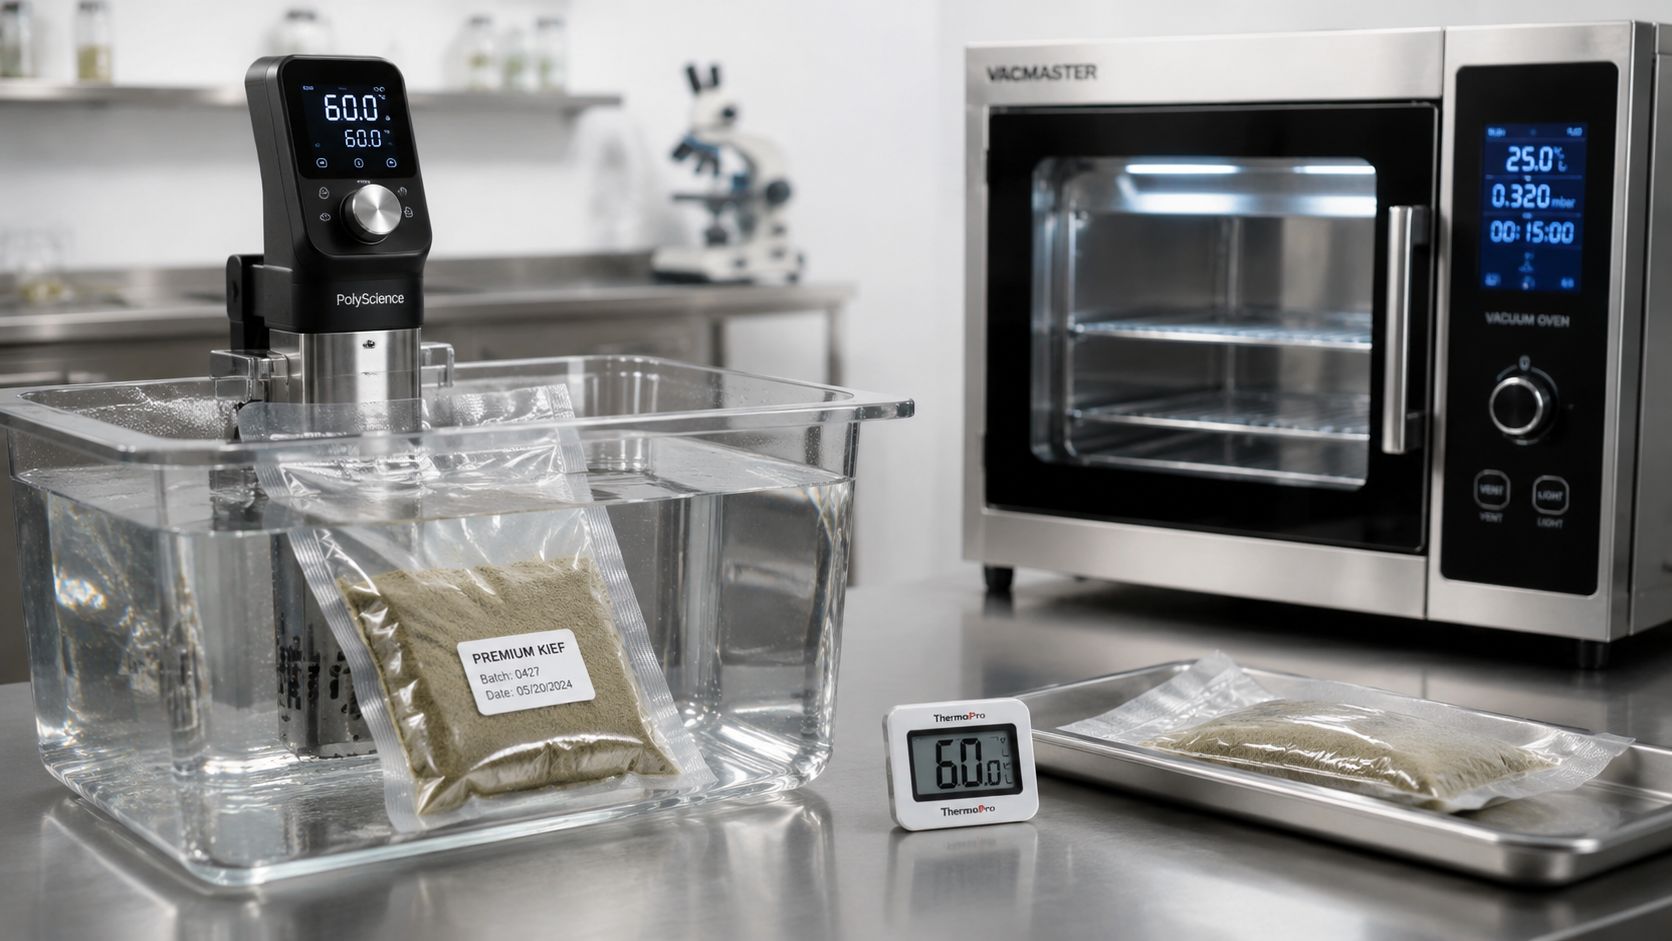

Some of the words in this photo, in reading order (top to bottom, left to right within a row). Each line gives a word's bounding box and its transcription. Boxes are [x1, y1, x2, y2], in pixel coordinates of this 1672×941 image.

[986, 64, 1097, 81] VACMASTER
[324, 94, 378, 121] 60.0
[344, 129, 381, 148] 60.0
[1506, 146, 1553, 172] 25.0
[1492, 183, 1550, 208] 0.320
[1490, 220, 1575, 244] 00:15:00
[336, 293, 405, 307] PolyScience
[1485, 312, 1535, 325] VACUUM
[1537, 314, 1570, 327] OVEN
[472, 646, 535, 664] PREMIUM
[537, 642, 566, 656] KIEF
[480, 671, 514, 684] Batch:
[514, 666, 540, 680] 0427
[485, 687, 514, 701] Date:
[516, 679, 573, 696] 05/20/2024
[933, 712, 986, 723] ThermoPro
